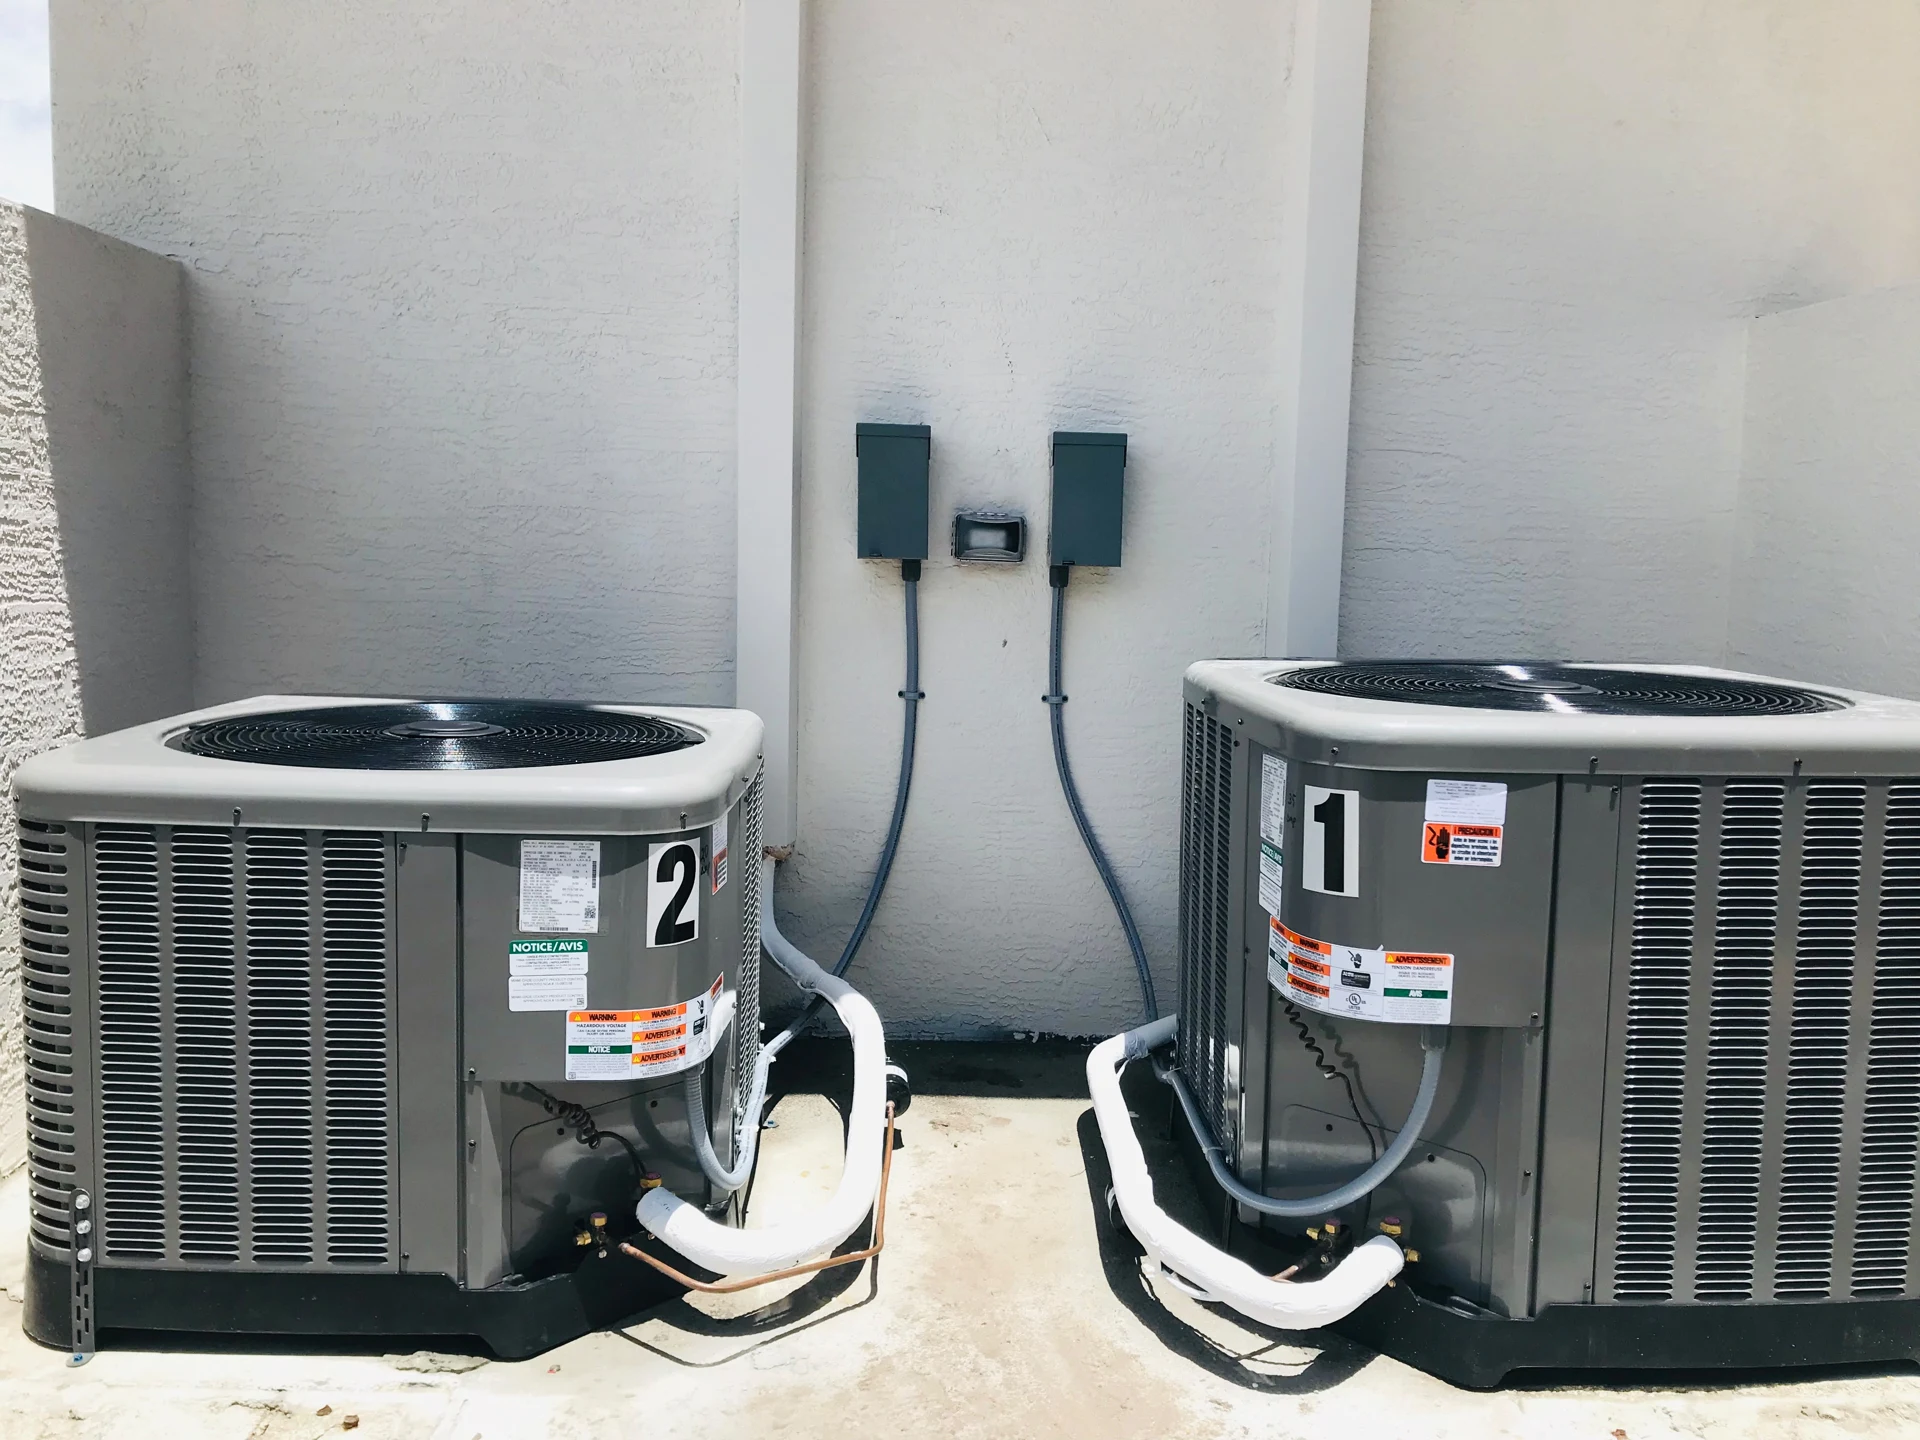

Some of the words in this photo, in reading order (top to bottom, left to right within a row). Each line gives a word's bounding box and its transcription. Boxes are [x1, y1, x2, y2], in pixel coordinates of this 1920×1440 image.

[1314, 793, 1345, 893] 1
[655, 844, 697, 946] 2
[512, 941, 584, 953] NOTICE/AVIS
[1395, 955, 1448, 965] ADVERTISSEMENT
[1408, 990, 1423, 998] AVIS
[589, 1013, 617, 1021] WARNING
[651, 1007, 677, 1018] WARNING
